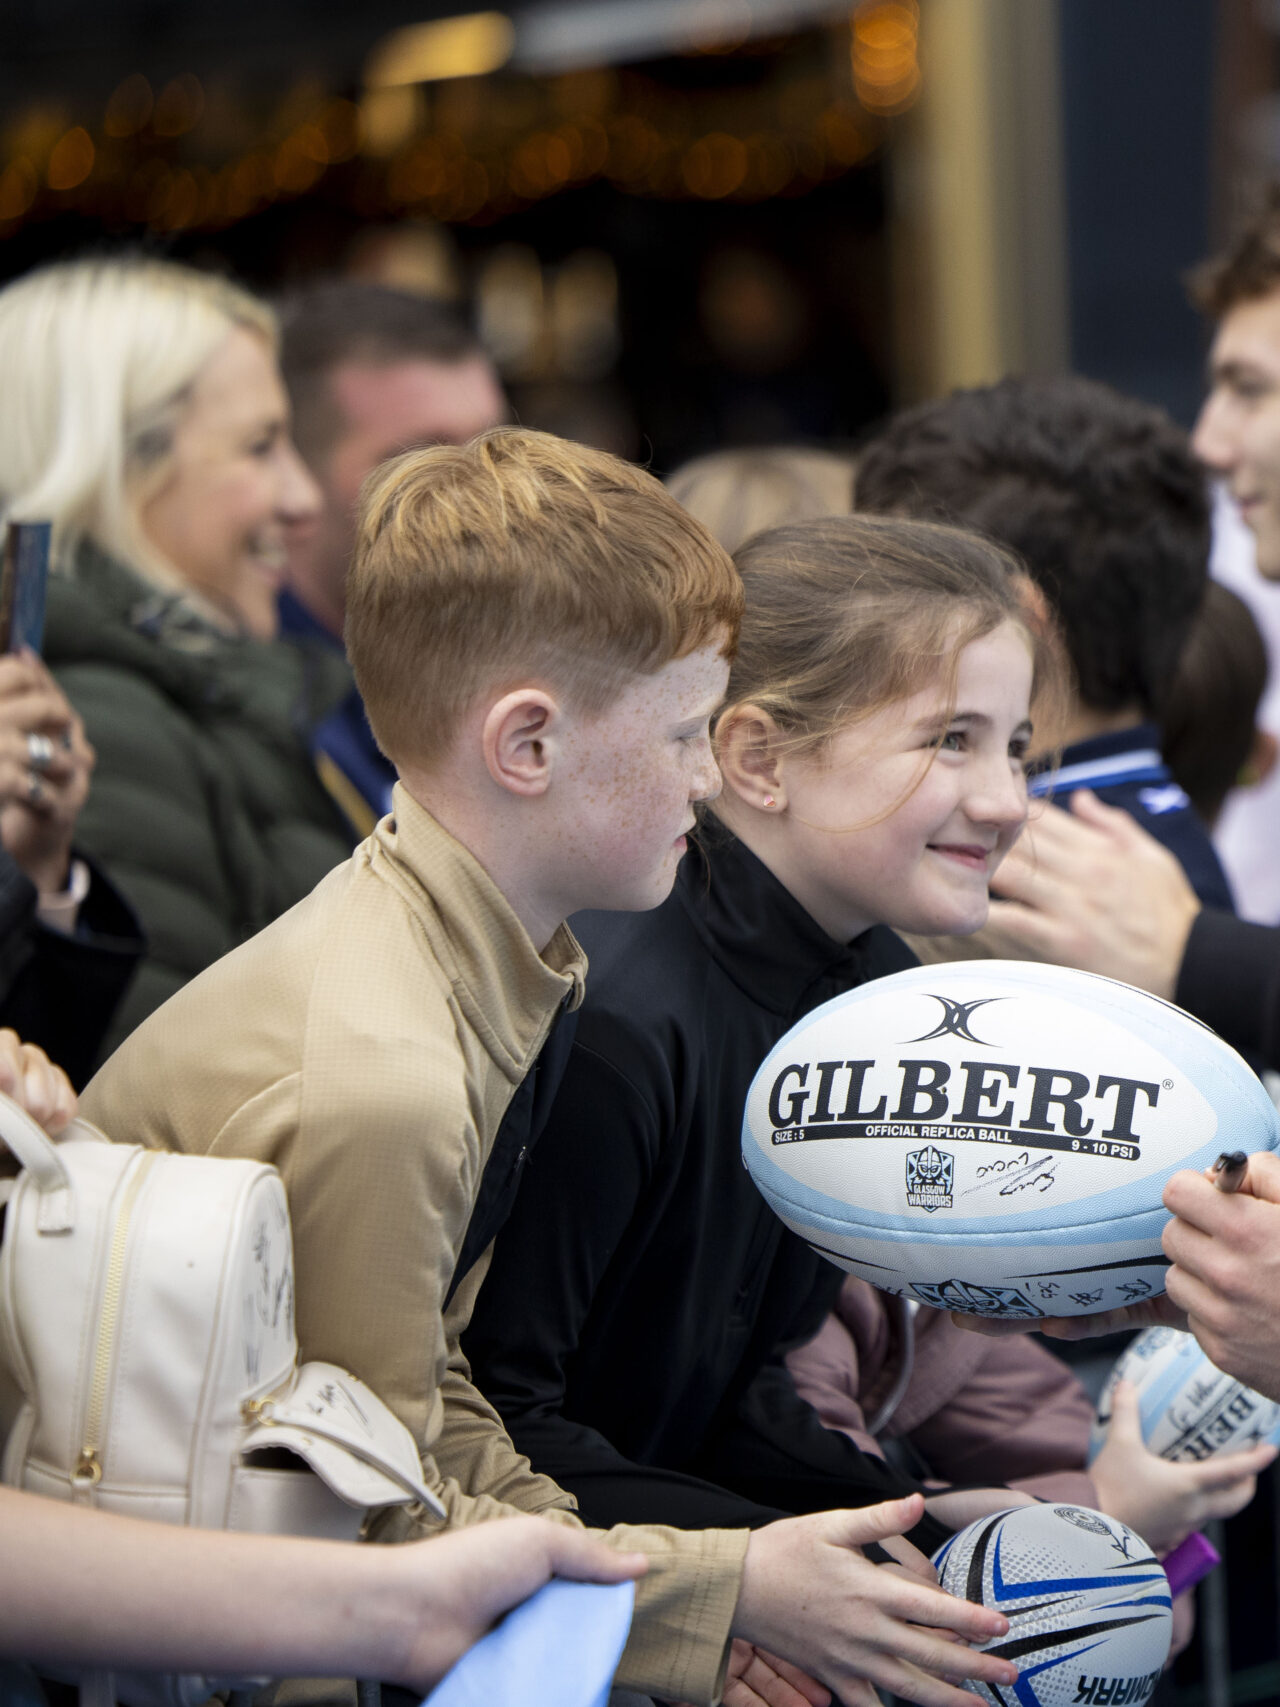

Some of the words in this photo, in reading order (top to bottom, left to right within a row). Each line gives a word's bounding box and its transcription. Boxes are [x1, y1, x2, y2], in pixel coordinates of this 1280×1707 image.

[768, 1059, 1160, 1144] GILBERT
[774, 1131, 793, 1143] SIZE
[799, 1130, 805, 1140] 5
[865, 1125, 918, 1137] OFFICIAL
[921, 1126, 975, 1140] REPLICA
[978, 1129, 1012, 1143] BALL
[1071, 1140, 1080, 1151] 9
[1092, 1143, 1108, 1154] 10
[1110, 1144, 1134, 1159] PSI
[913, 1184, 946, 1195] GLASGOW
[908, 1195, 952, 1208] WARRIORS
[1170, 1393, 1258, 1463] BER
